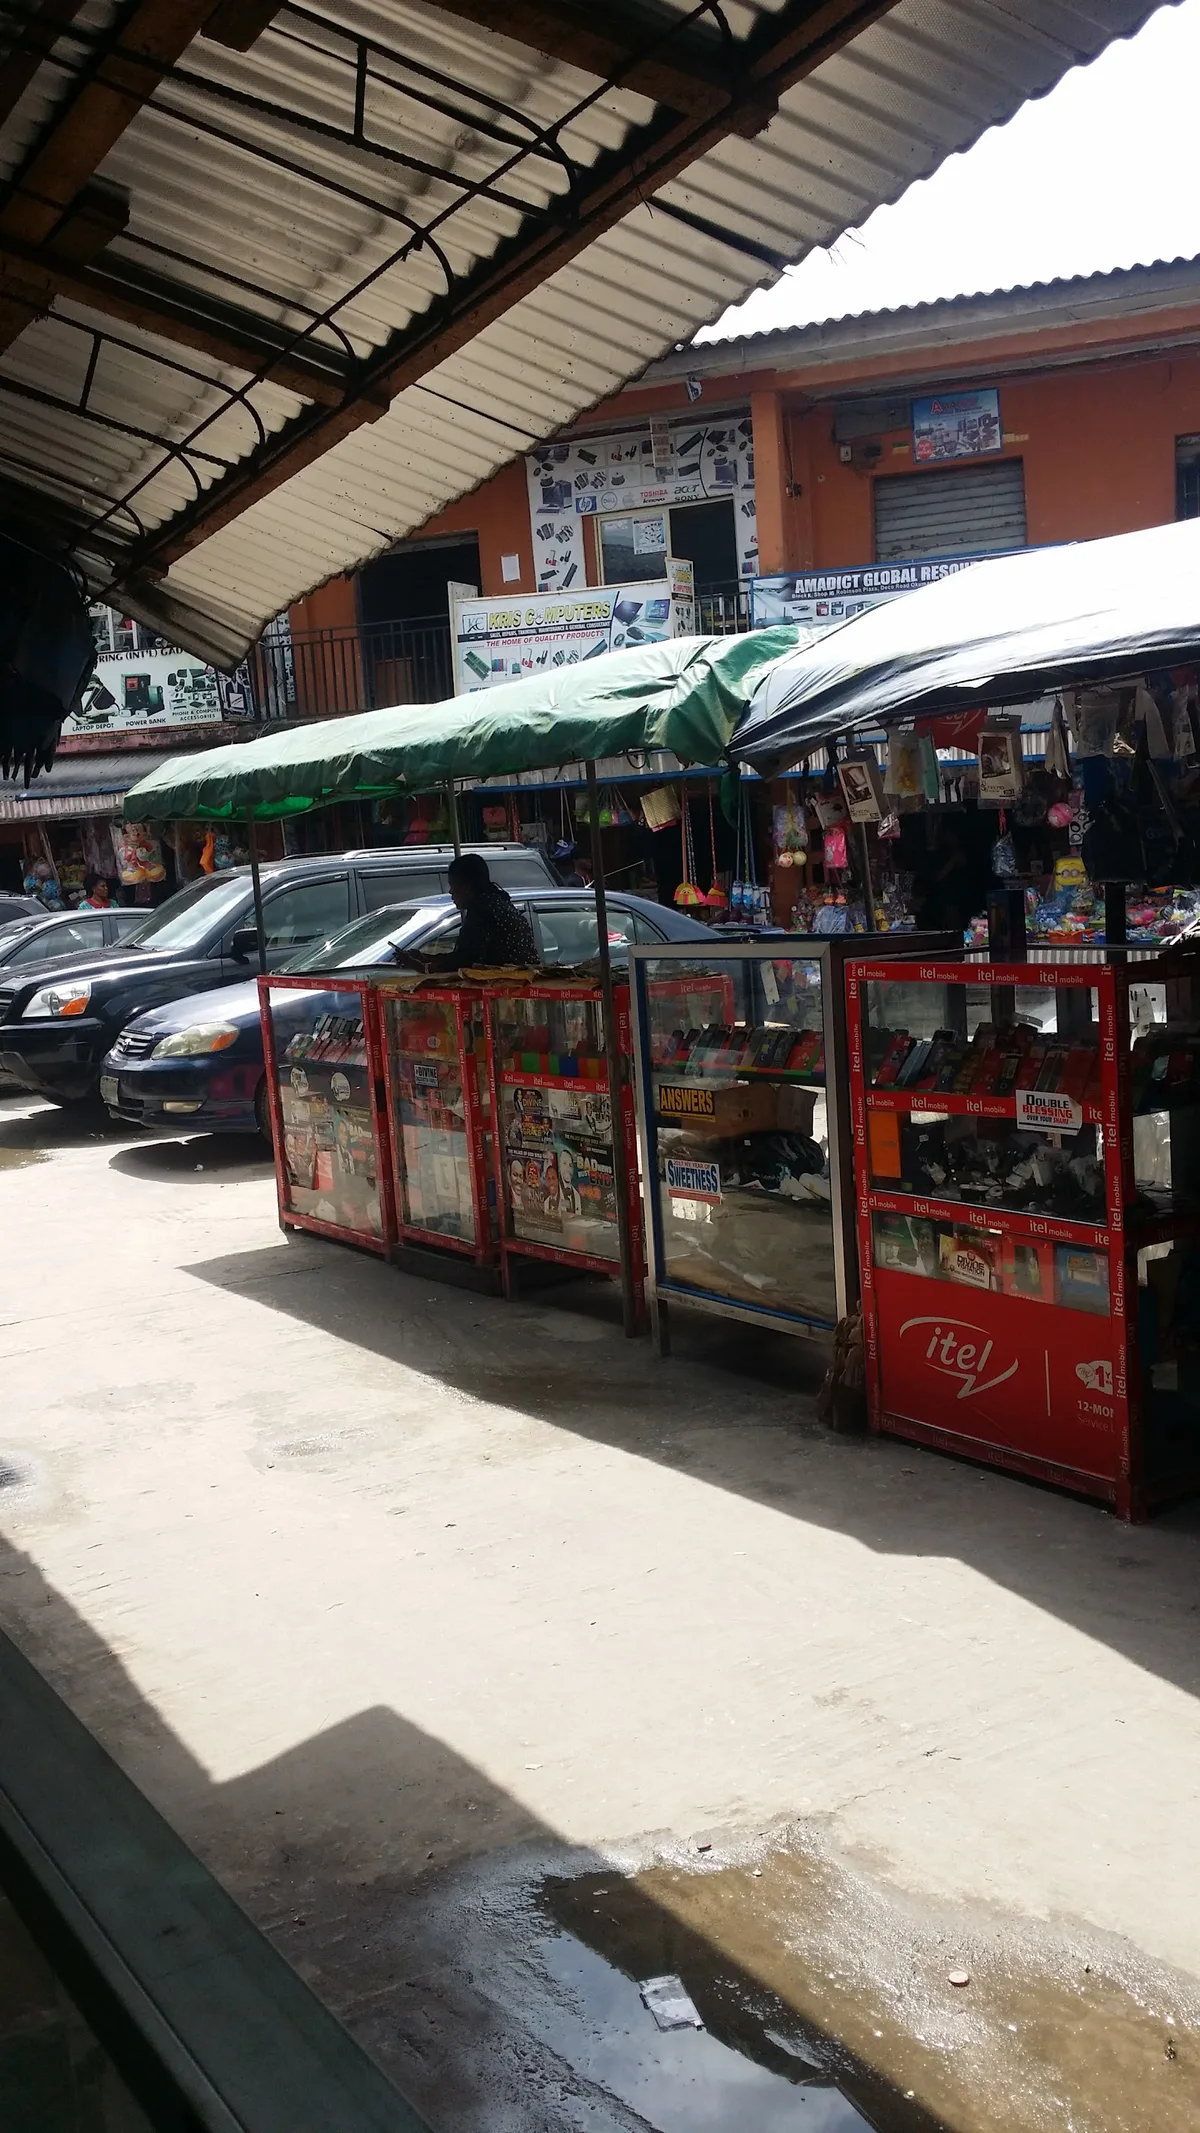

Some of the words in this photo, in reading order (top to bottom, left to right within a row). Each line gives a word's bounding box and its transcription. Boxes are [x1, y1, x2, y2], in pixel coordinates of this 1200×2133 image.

[640, 489, 668, 498] TOSHIBA
[674, 484, 700, 495] acer
[794, 573, 862, 594] AMADICT
[863, 567, 918, 587] GLOBAL
[920, 562, 974, 582] RESO
[836, 587, 862, 595] Robinson
[895, 582, 910, 590] Road
[488, 611, 522, 630] KRIS
[525, 601, 612, 626] COMPUTERS
[501, 637, 522, 646] HOME
[523, 636, 533, 644] OF
[534, 632, 566, 643] QUALITY
[566, 629, 605, 640] PRODUCTS
[125, 719, 148, 727] POWER
[148, 717, 167, 725] BANK
[179, 713, 216, 722] ACCESSORIES
[72, 724, 94, 732] LAPTOP
[95, 722, 115, 731] DEPOT
[866, 970, 887, 978] mobile
[920, 966, 936, 979] itel
[936, 971, 959, 980] mobile
[977, 968, 995, 982] itel
[995, 972, 1019, 983] mobile
[1039, 969, 1058, 984] itel
[1059, 974, 1084, 986] mobile
[560, 990, 571, 999] itel
[680, 983, 695, 993] itel
[848, 978, 858, 999] itel
[619, 1012, 628, 1029] itel
[1103, 1037, 1115, 1062] itel
[851, 1051, 861, 1073] itel
[504, 1074, 514, 1083] itel
[533, 1077, 543, 1086] itel
[563, 1079, 574, 1089] itel
[595, 1082, 606, 1092] itel
[471, 1090, 480, 1109] itel
[660, 1087, 713, 1114] ANSWERS
[875, 1098, 895, 1108] mobile
[911, 1096, 927, 1109] itel
[927, 1100, 949, 1111] mobile
[966, 1099, 983, 1113] itel
[983, 1104, 1006, 1115] mobile
[1026, 1094, 1070, 1109] DOUBLE
[623, 1110, 633, 1127] itel
[1022, 1104, 1073, 1119] BLESSING
[1040, 1115, 1053, 1123] YOUR
[856, 1123, 865, 1146] itel
[1106, 1122, 1118, 1148] itel
[476, 1143, 485, 1160] itel
[576, 1155, 598, 1172] BAD
[692, 1161, 704, 1169] YEAR
[628, 1167, 637, 1185] itel
[667, 1160, 718, 1193] SWEETNESS
[1112, 1175, 1120, 1206] mobile
[860, 1195, 869, 1218] itel
[878, 1199, 897, 1210] mobile
[913, 1201, 929, 1214] itel
[929, 1205, 951, 1218] mobile
[969, 1211, 987, 1225] itel
[987, 1216, 1010, 1230] mobile
[1110, 1206, 1122, 1232] itel
[631, 1224, 640, 1242] itel
[1029, 1220, 1048, 1234] itel
[1048, 1226, 1073, 1240] mobile
[957, 1254, 985, 1269] DIVINE
[863, 1266, 872, 1289] itel
[1116, 1260, 1124, 1292] mobile
[1113, 1291, 1125, 1317] itel
[867, 1339, 877, 1361] itel
[926, 1326, 994, 1374] itel
[1115, 1374, 1127, 1400] itel
[1077, 1415, 1109, 1432] Service
